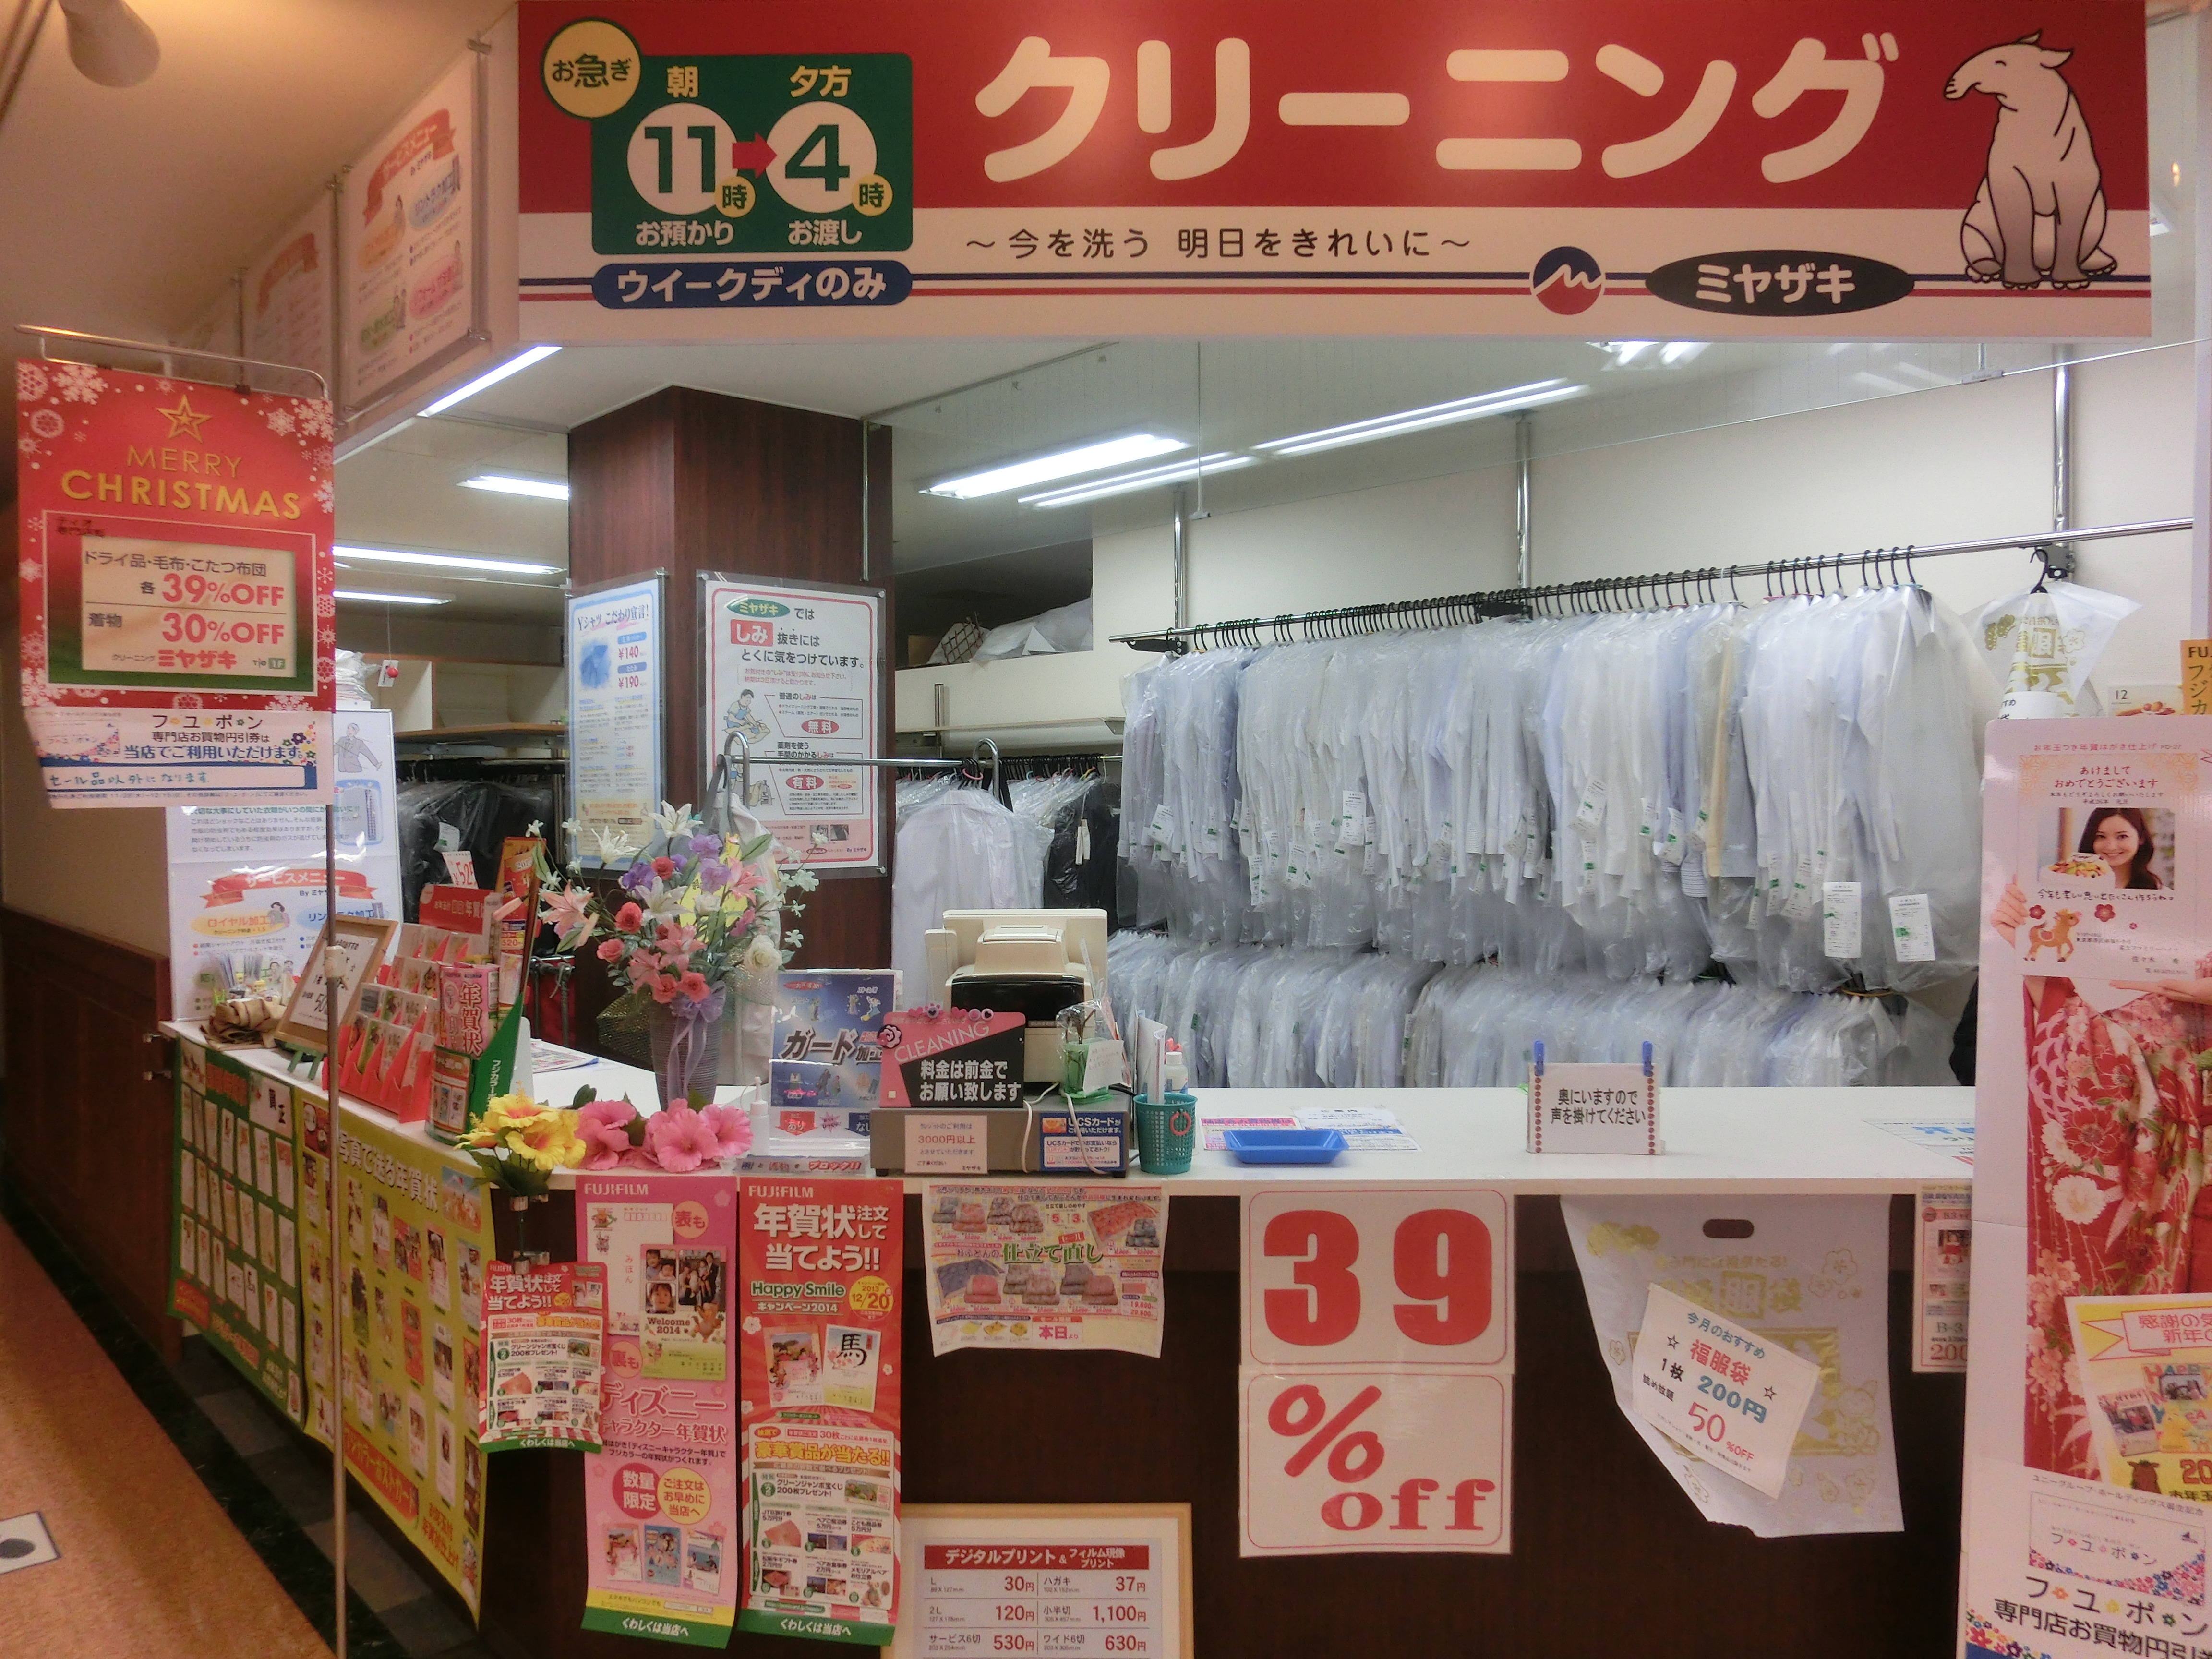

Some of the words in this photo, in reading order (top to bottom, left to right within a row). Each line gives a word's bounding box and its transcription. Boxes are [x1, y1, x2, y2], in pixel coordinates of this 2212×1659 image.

[552, 53, 631, 87] お急ぎ
[667, 66, 698, 97] 朝
[790, 66, 852, 97] 夕方
[975, 32, 1899, 183] クリーニング
[645, 125, 716, 193] 11
[722, 185, 747, 210] 時
[784, 124, 850, 192] 4
[859, 183, 884, 208] 時
[636, 220, 734, 247] お預かり
[788, 219, 862, 246] お渡し
[617, 266, 888, 303] ウイークディのみ
[1695, 263, 1856, 304] ミヤザキ
[127, 445, 241, 478] MERRY
[61, 470, 301, 519] CHRISTMAS
[140, 581, 156, 594] 各
[162, 573, 284, 606] 39%OFF
[739, 601, 779, 616] ミヤザキ
[794, 607, 815, 620] では
[89, 613, 122, 628] 着物
[162, 613, 284, 644] 30%OFF
[736, 624, 769, 644] しみ
[777, 632, 820, 647] 抜きには
[158, 649, 237, 669] ミヤザキ
[741, 649, 865, 668] とくに気をつけています。
[779, 692, 816, 700] 普通のしみは
[807, 721, 832, 733] 無料
[777, 741, 809, 750] 薬剤を使う
[777, 750, 834, 759] 手間のかかるしみは
[2080, 766, 2131, 776] あけまして
[792, 777, 817, 789] 有料
[2055, 779, 2158, 789] おめでとうございます
[207, 916, 269, 927] ロイヤル加工
[460, 982, 482, 1057] 年賀状
[894, 1020, 990, 1063] CLEANING
[921, 1059, 1008, 1080] 料金は前金で
[919, 1082, 1022, 1102] お願い致します
[1558, 1088, 1638, 1106] 奥にいますので
[1551, 1107, 1646, 1125] 声を掛けてください
[918, 1135, 975, 1144] 3000円以上
[584, 1184, 649, 1195] FUJIFILM
[748, 1185, 814, 1198] FUJIFILM
[675, 1211, 705, 1229] 表も
[754, 1203, 856, 1239] 年賀状
[857, 1204, 889, 1222] 注文
[858, 1225, 887, 1240] して
[766, 1243, 880, 1272] 当てよう!!
[1002, 1242, 1104, 1264] 仕立て直し
[625, 1255, 633, 1284] みほん
[1264, 1208, 1492, 1346] 39
[490, 1274, 544, 1293] 年賀状
[751, 1281, 802, 1298] Happy
[805, 1282, 846, 1297] Smile
[757, 1301, 838, 1313] キャンペーン2014
[852, 1291, 889, 1309] 12/20
[647, 1317, 690, 1327] Welcome
[657, 1326, 681, 1334] 2014
[1687, 1311, 1766, 1360] 今月のおすすめ
[837, 1333, 867, 1369] 馬
[1690, 1339, 1752, 1387] 福服袋
[1660, 1358, 1684, 1382] 1枚
[1697, 1374, 1767, 1424] 200円
[1688, 1401, 1726, 1442] 50
[1726, 1440, 1755, 1462] %OFF
[755, 1441, 890, 1466] 豪華賞品が当たる!!
[623, 1470, 655, 1490] 数量
[664, 1478, 704, 1491] ご注文は
[624, 1491, 656, 1511] 限定
[664, 1491, 705, 1504] お早めに
[1321, 1478, 1495, 1532] off
[669, 1505, 700, 1516] 当店へ
[946, 1549, 1055, 1565] デジタルプリント
[1069, 1548, 1125, 1558] フィルム現像
[1081, 1559, 1114, 1568] プリント
[1004, 1576, 1034, 1592] 30円
[1044, 1577, 1070, 1585] ハガキ
[1115, 1576, 1145, 1592] 37円
[996, 1605, 1034, 1622] 120円
[1044, 1606, 1070, 1614] 小半切
[1093, 1605, 1146, 1623] 1,100円
[622, 1617, 689, 1636] くわしくは当店へ
[780, 1618, 851, 1637] くわしくは当店へ
[1994, 1597, 2212, 1659] 専門店お買物円引
[993, 1635, 1034, 1651] 530円
[1105, 1635, 1146, 1651] 630円
